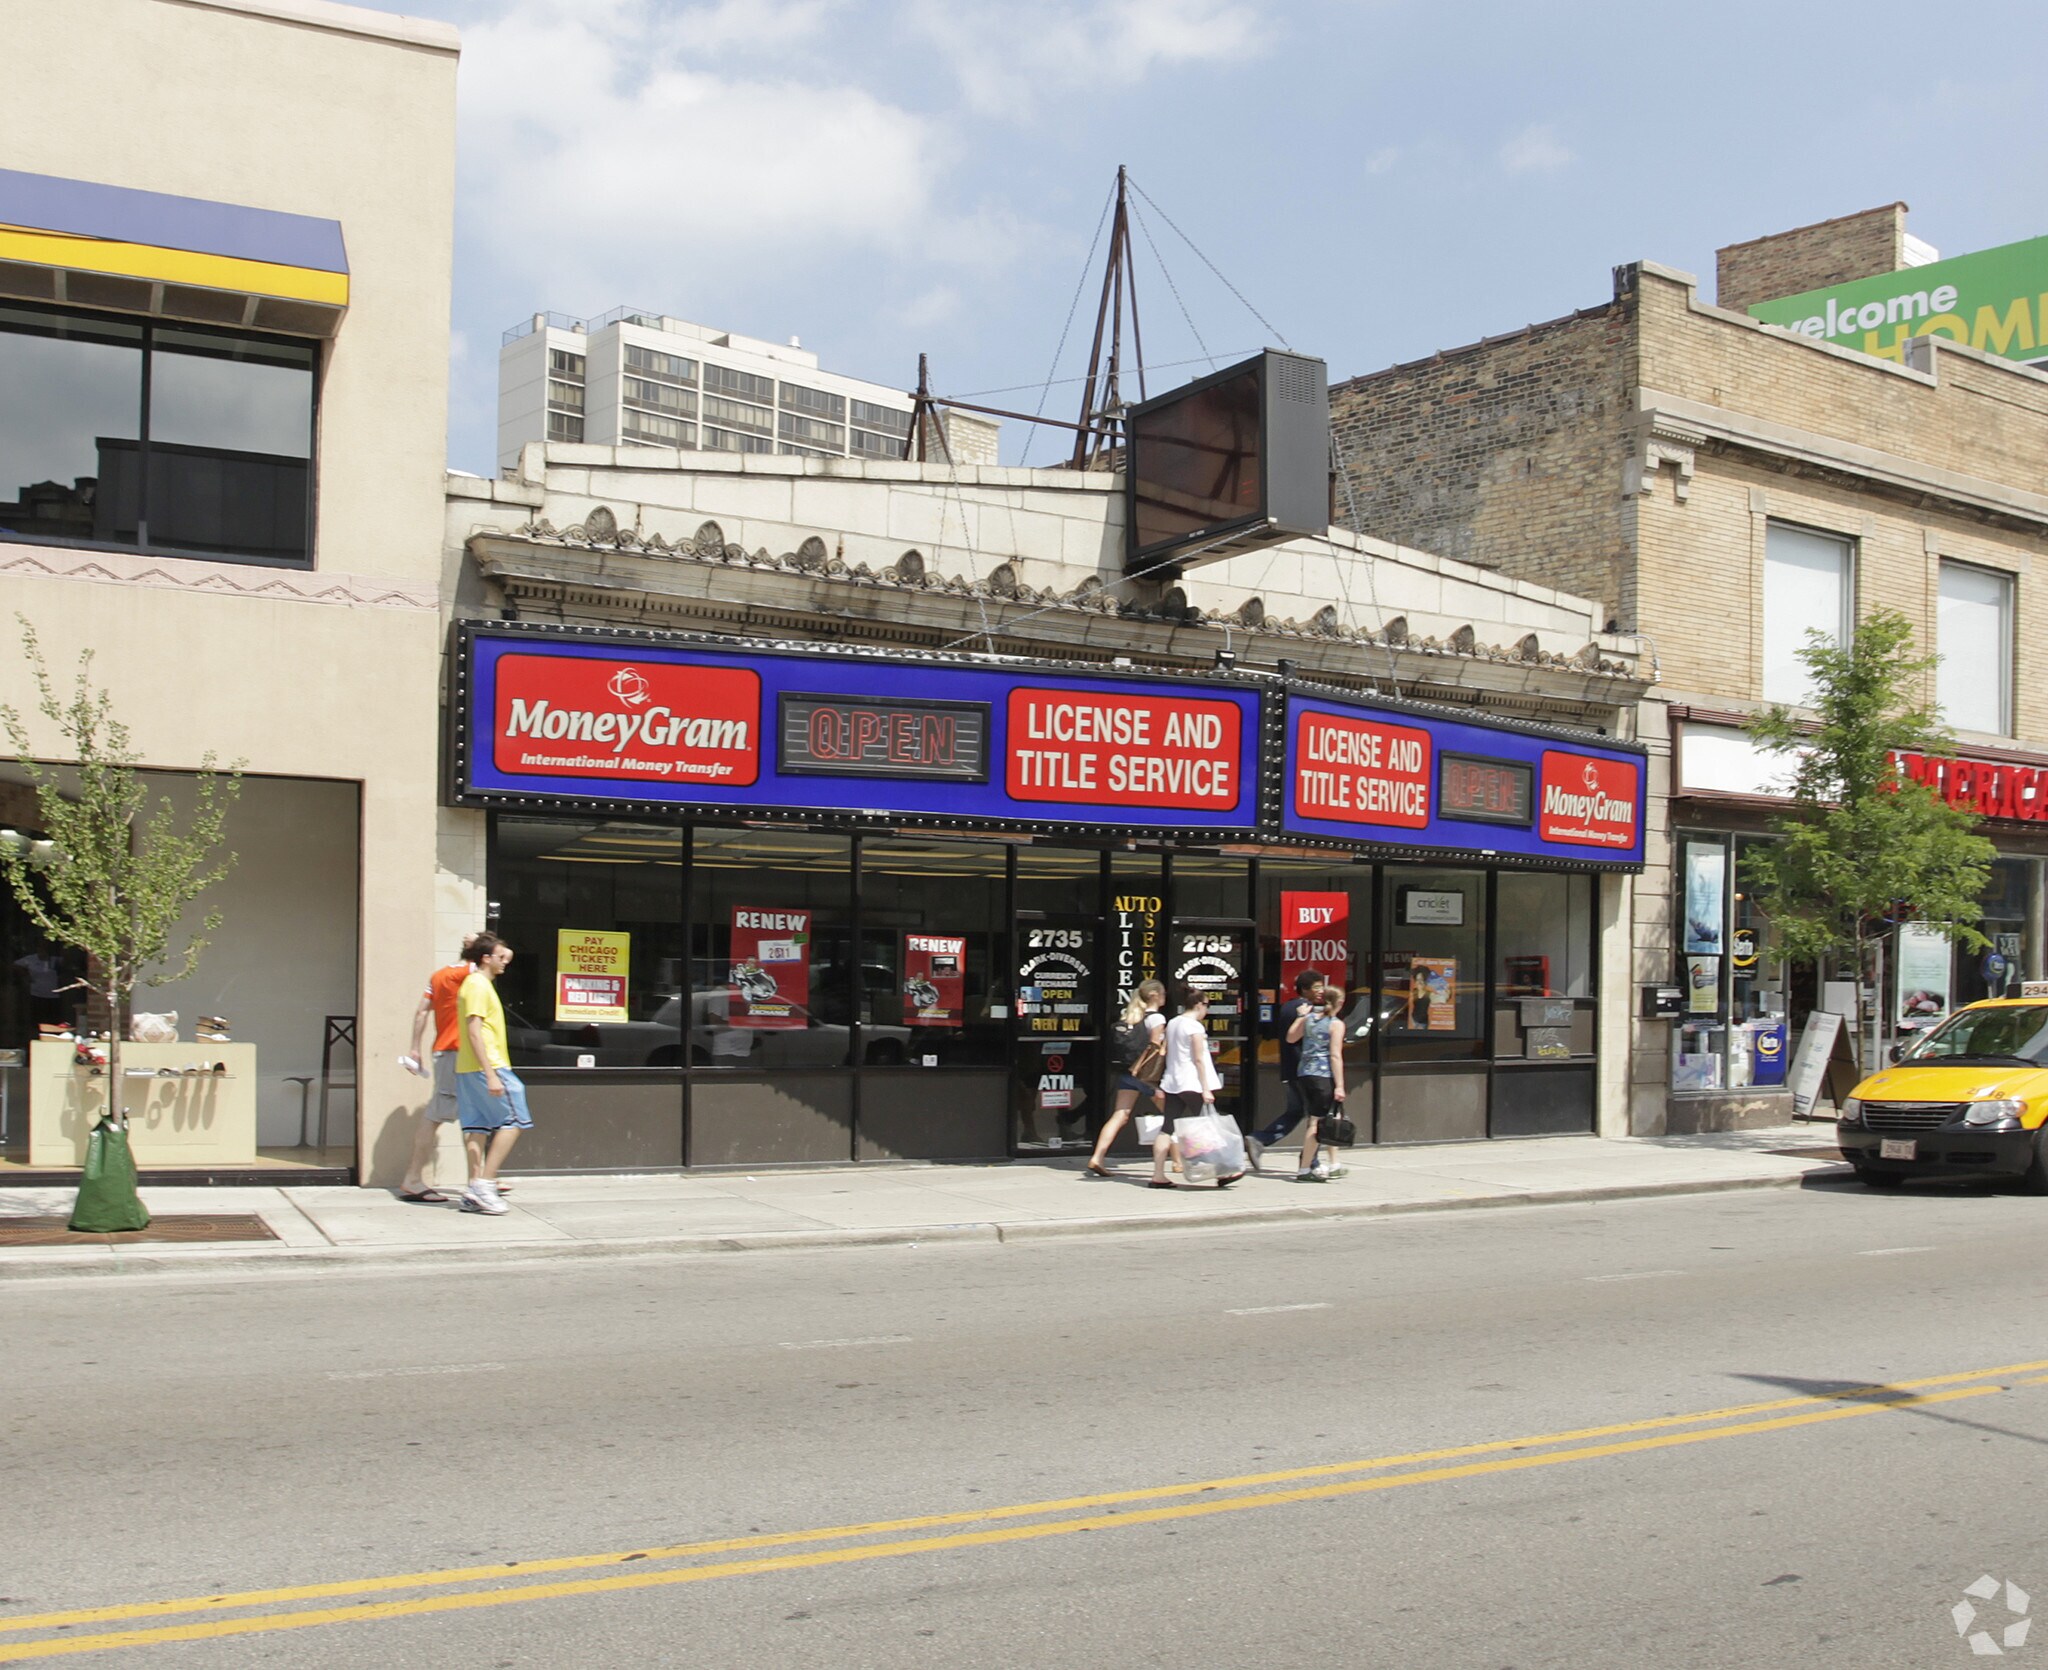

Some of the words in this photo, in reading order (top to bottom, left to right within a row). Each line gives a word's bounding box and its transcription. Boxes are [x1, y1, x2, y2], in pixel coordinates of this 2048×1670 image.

[1780, 285, 1958, 340] elcome
[1864, 292, 2048, 366] HOM
[505, 698, 749, 752] MoneyGram
[1028, 703, 1150, 746] LICENSE
[1162, 712, 1223, 750] AND
[808, 707, 955, 765] OPEN
[1308, 726, 1382, 768] LICENSE
[1388, 738, 1422, 774] AND
[520, 753, 619, 770] International
[621, 757, 672, 775] Money
[676, 760, 733, 777] Transfer
[1016, 750, 1096, 789] TITLE
[1108, 754, 1229, 797] SERVICE
[1300, 769, 1350, 808] TITLE
[1356, 776, 1425, 816] SERVICE
[1544, 784, 1632, 825] MoneyGram
[1113, 896, 1162, 913] AUTO
[736, 911, 807, 932] RENEW
[1298, 907, 1334, 924] BUY
[584, 936, 605, 945] PAY
[908, 937, 963, 954] RENEW
[1028, 929, 1083, 949] 2735
[1182, 935, 1233, 954] 2735
[569, 945, 618, 955] CHICAGO
[571, 954, 617, 964] TICKETS
[1283, 939, 1347, 962] EUROS
[579, 964, 607, 973] HERE
[1033, 972, 1077, 980] CURRENCY
[1041, 989, 1072, 999] OPEN
[1031, 1018, 1058, 1031] EVERY
[1062, 1018, 1081, 1031] DAY
[1038, 1075, 1074, 1090] ATM
